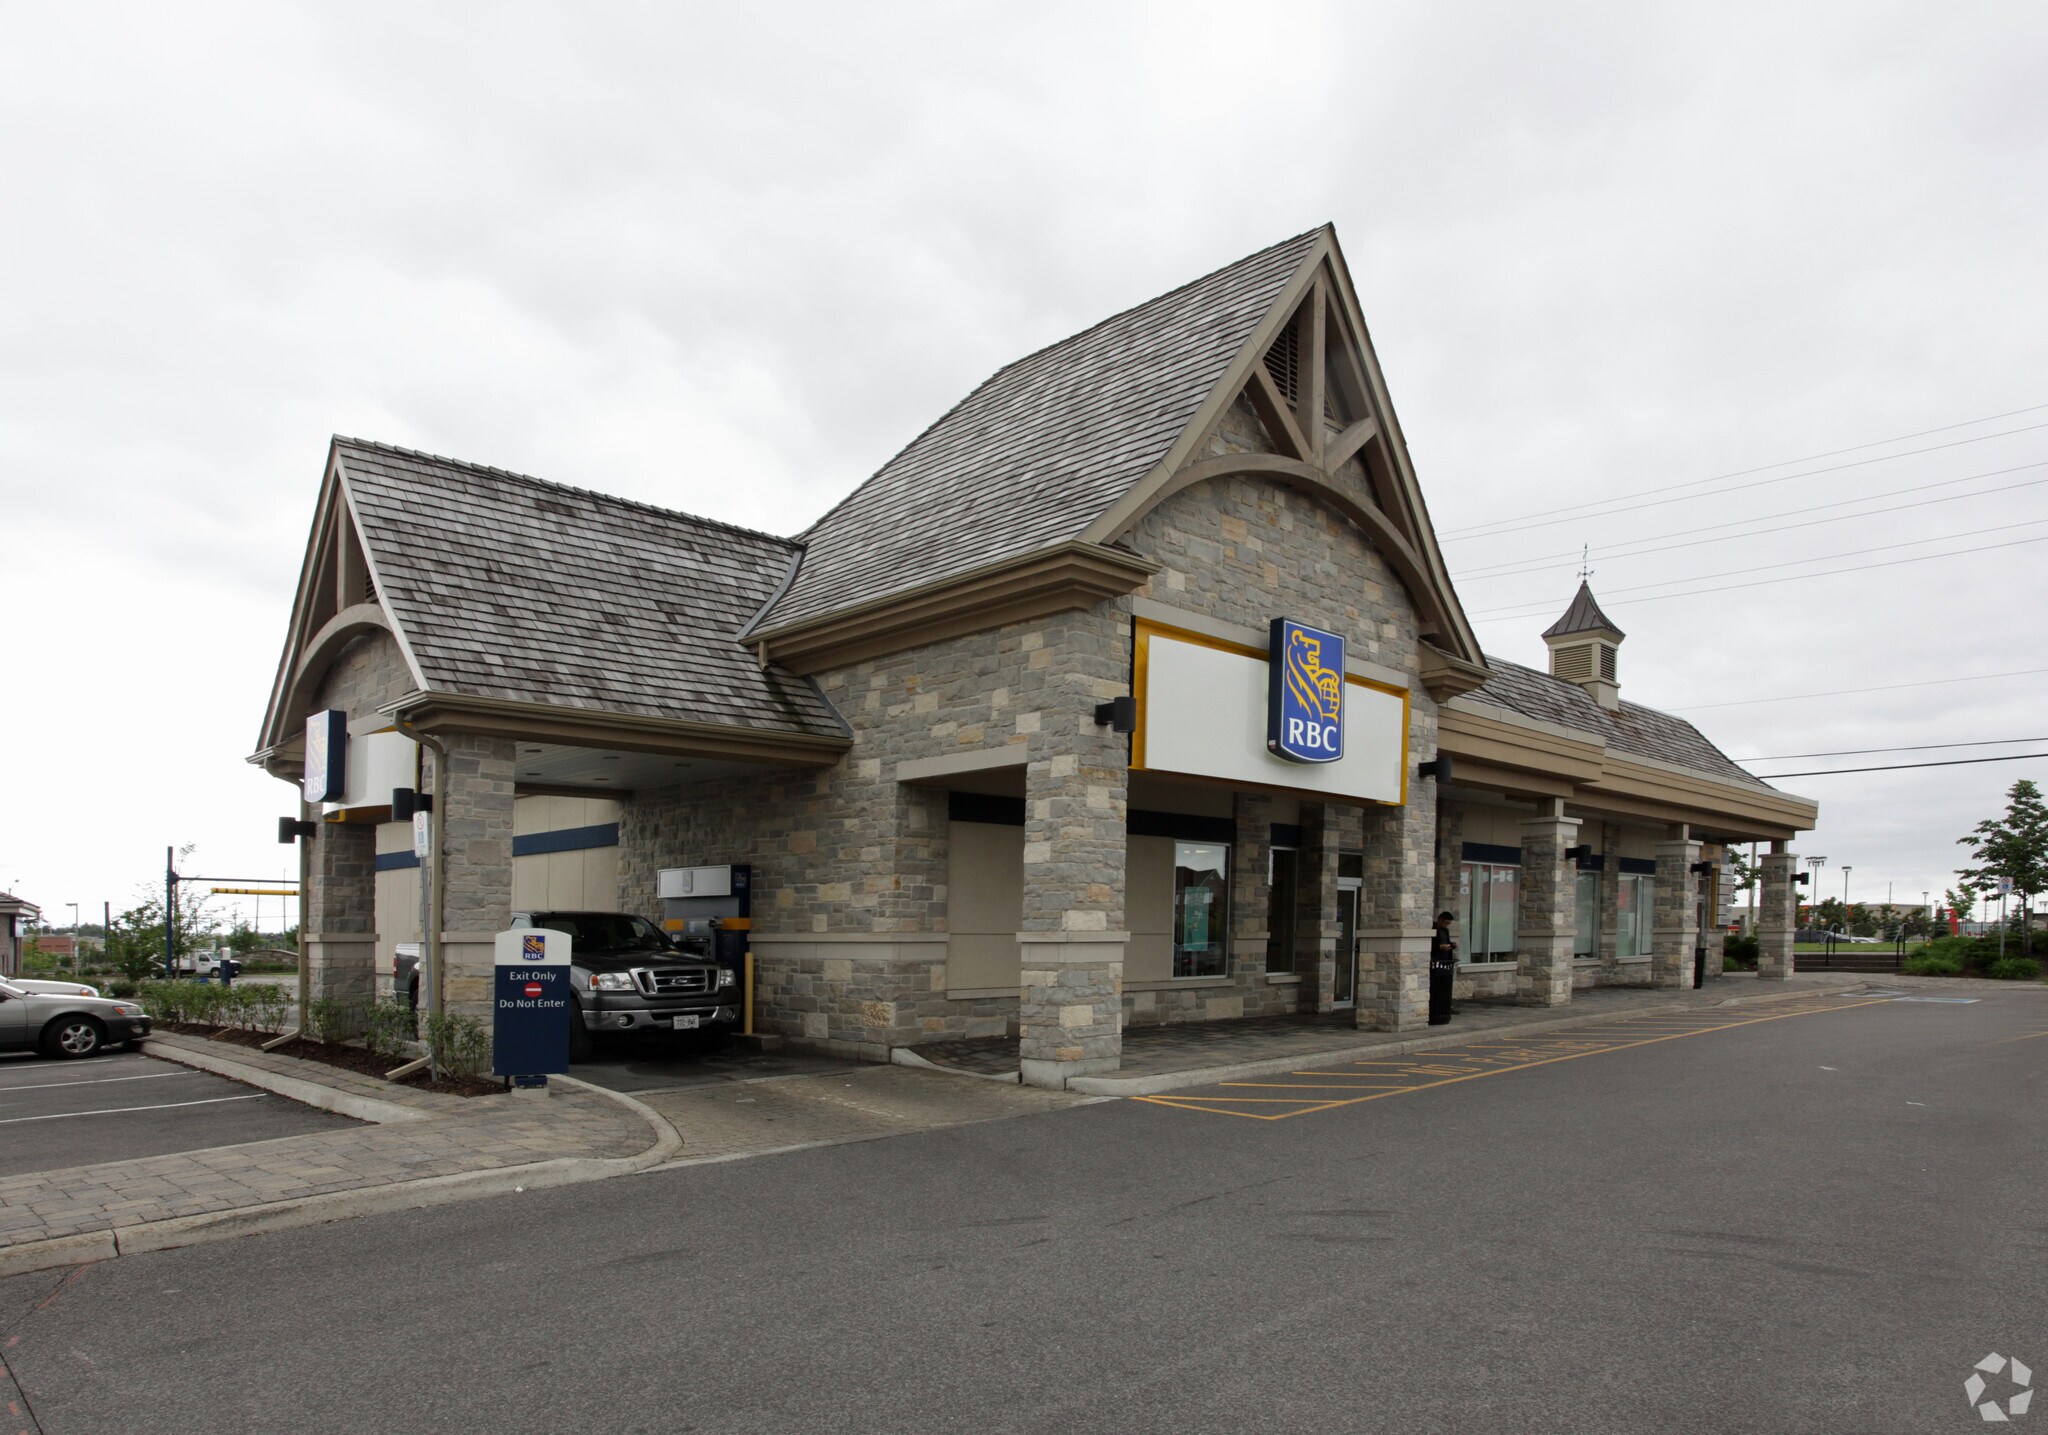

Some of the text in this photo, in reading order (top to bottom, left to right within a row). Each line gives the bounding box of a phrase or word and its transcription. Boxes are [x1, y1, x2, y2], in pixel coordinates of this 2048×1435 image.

[1288, 717, 1337, 752] RBC
[306, 774, 326, 795] RBC
[524, 952, 544, 960] RBC
[509, 971, 557, 983] Exit Only
[499, 999, 565, 1008] Do Not Enter
[1397, 1064, 1483, 1076] NO
